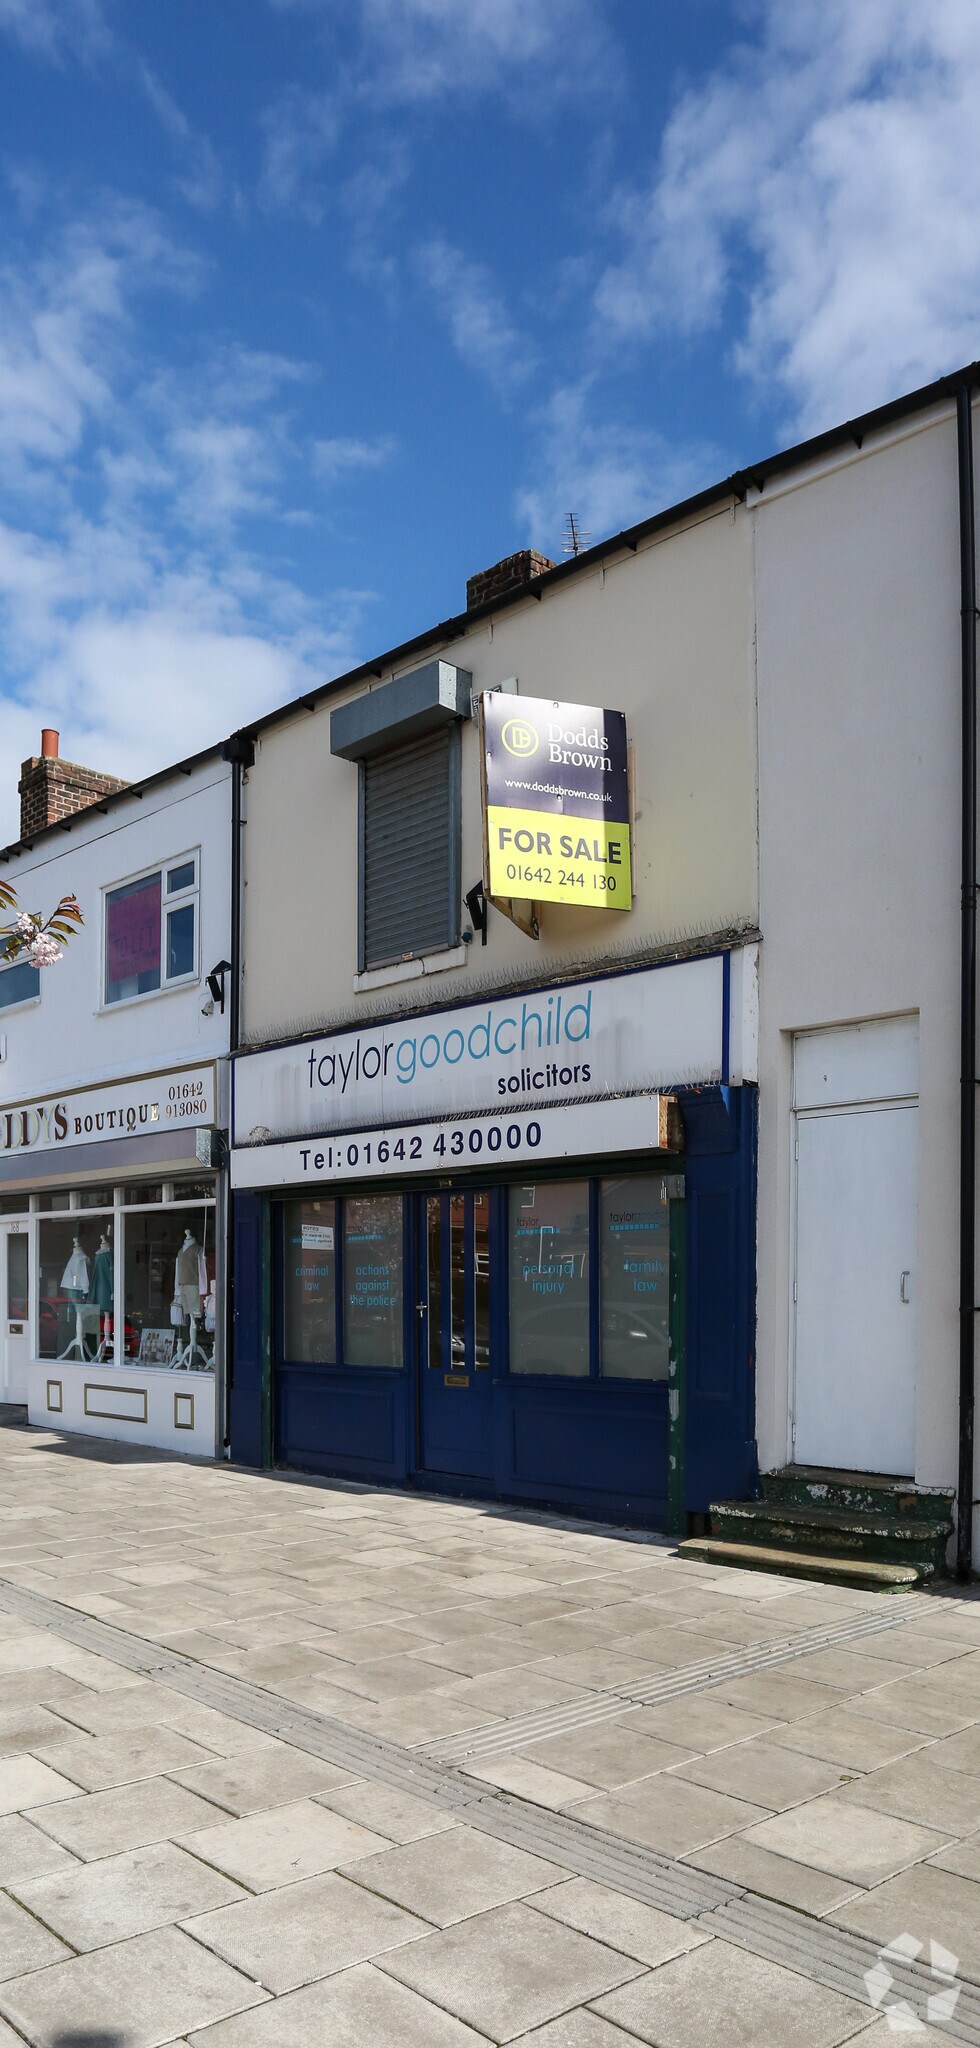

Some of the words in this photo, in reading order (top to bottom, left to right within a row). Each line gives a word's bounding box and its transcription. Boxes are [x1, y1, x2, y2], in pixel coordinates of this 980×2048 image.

[548, 723, 609, 751] Dodds
[548, 743, 613, 771] Brown
[504, 778, 612, 803] www.doddsbrown.co.uk
[498, 827, 552, 856] FOR
[560, 835, 622, 865] SALE
[506, 864, 552, 884] 01642
[558, 871, 585, 888] 244
[593, 874, 617, 891] 130
[131, 923, 154, 954] LET
[497, 1063, 592, 1096] solicitors
[168, 1081, 204, 1101] 01642
[74, 1102, 160, 1135] BOUTIQUE
[165, 1098, 207, 1119] 913080
[433, 1121, 542, 1157] 430000
[295, 1265, 329, 1277] criminal
[355, 1264, 389, 1276] actions
[522, 1260, 576, 1278] personal
[624, 1259, 667, 1276] family
[304, 1280, 319, 1291] law
[355, 1280, 390, 1294] against
[532, 1280, 565, 1296] injury
[633, 1278, 658, 1292] law
[349, 1294, 364, 1306] the
[366, 1294, 396, 1308] police
